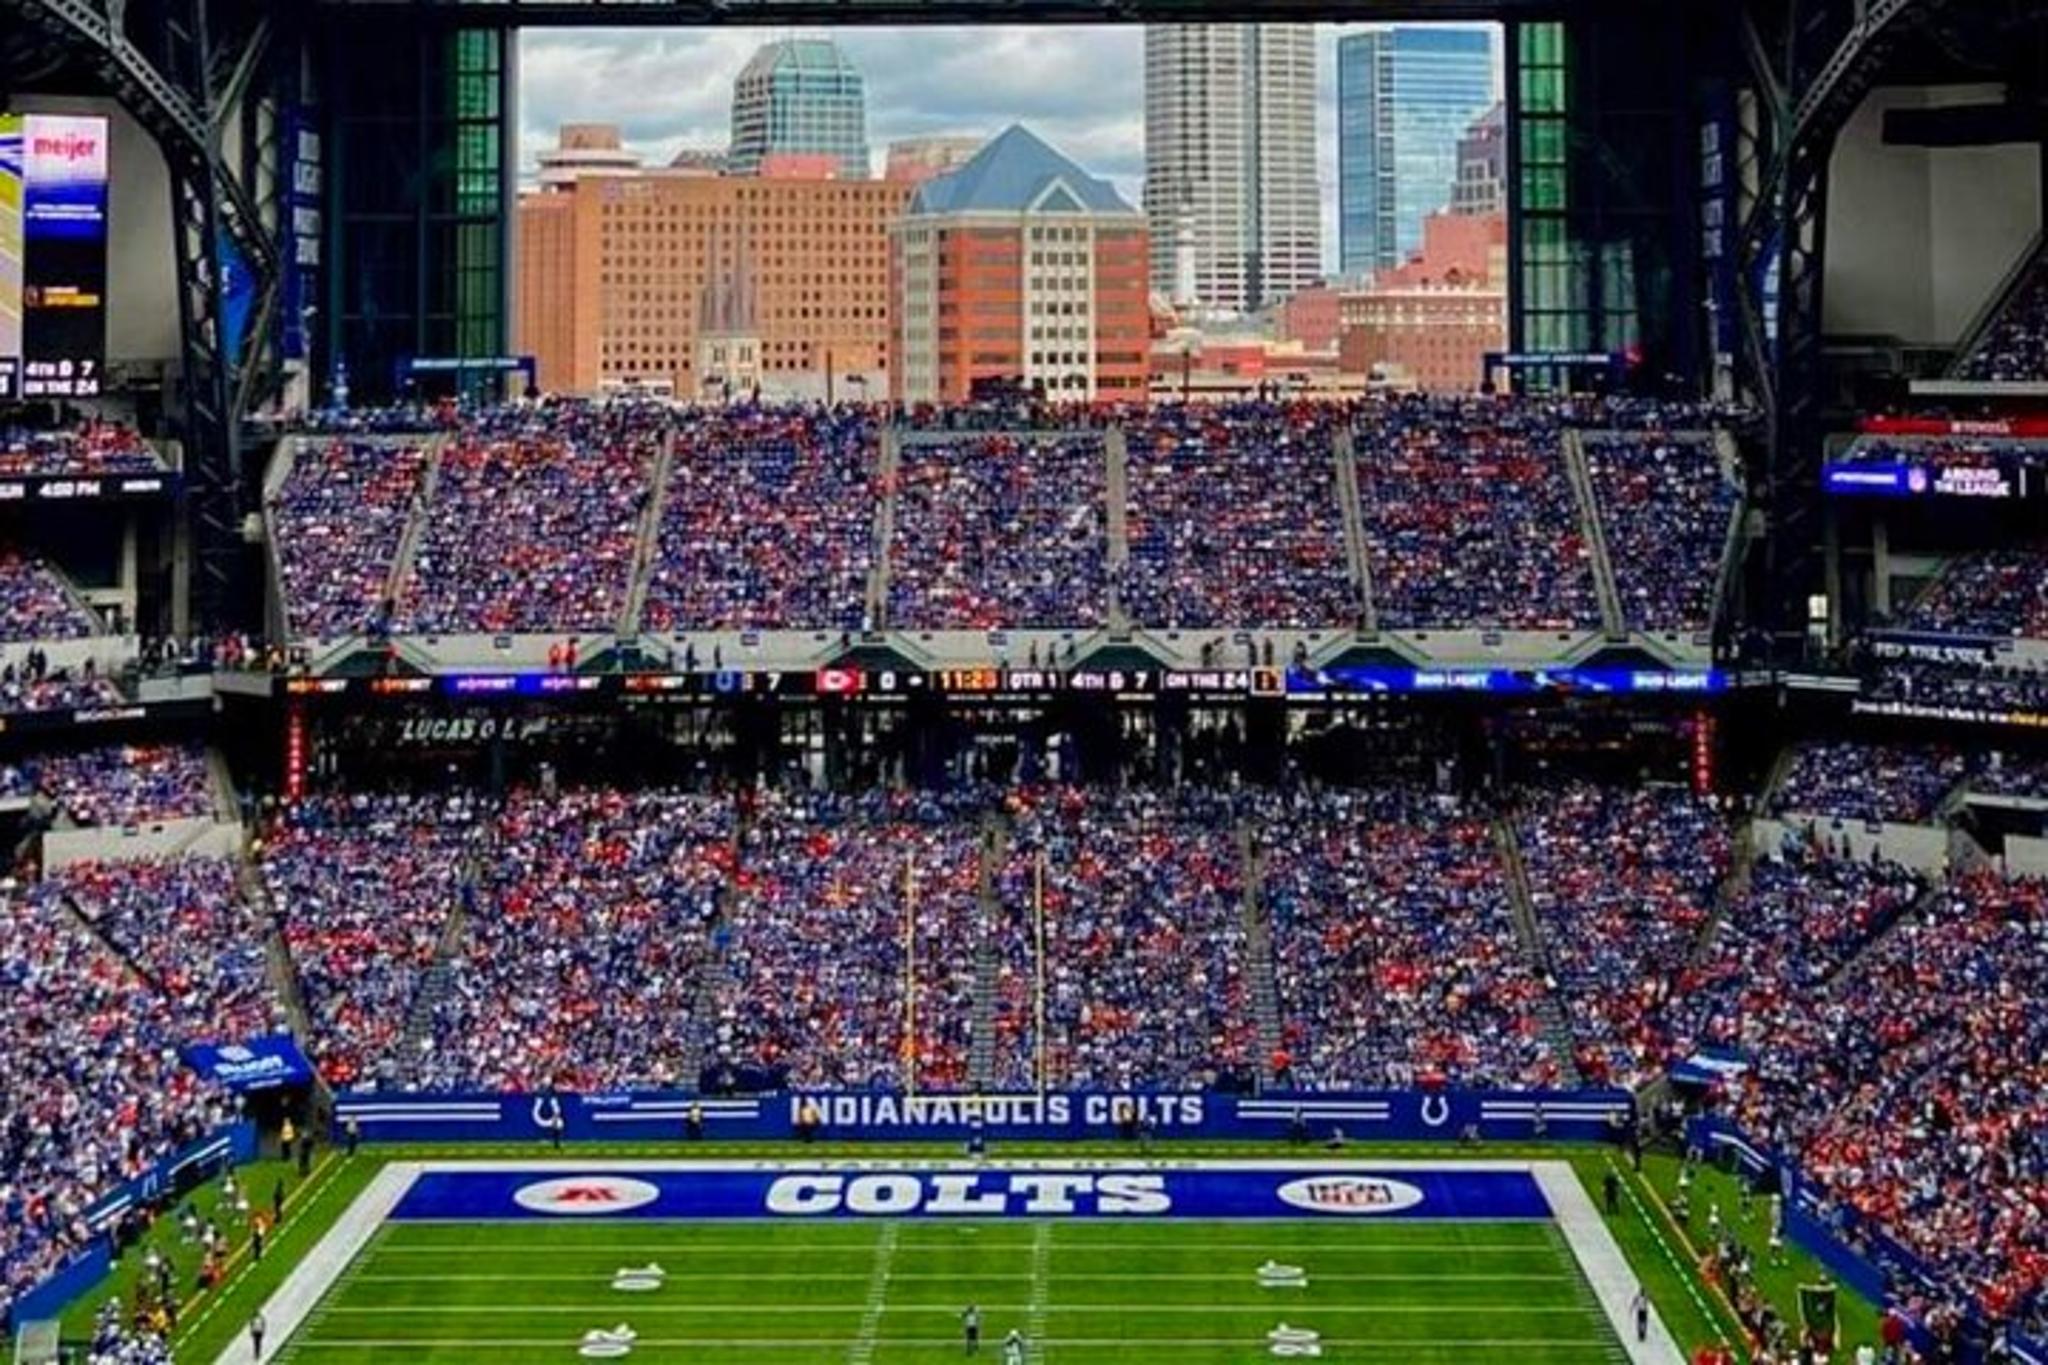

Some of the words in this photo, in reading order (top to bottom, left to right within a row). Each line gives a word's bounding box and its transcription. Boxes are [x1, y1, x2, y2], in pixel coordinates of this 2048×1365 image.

[33, 132, 95, 160] meijer
[767, 672, 781, 691] 7
[1071, 672, 1104, 689] 4TH
[1135, 672, 1148, 689] 7
[1222, 672, 1249, 689] 24
[403, 718, 476, 741] LUCAS
[479, 718, 516, 741] OL
[791, 1096, 1070, 1125] INDIANAPOLIS
[1086, 1096, 1203, 1124] COLTS
[765, 1174, 1172, 1214] COLTS
